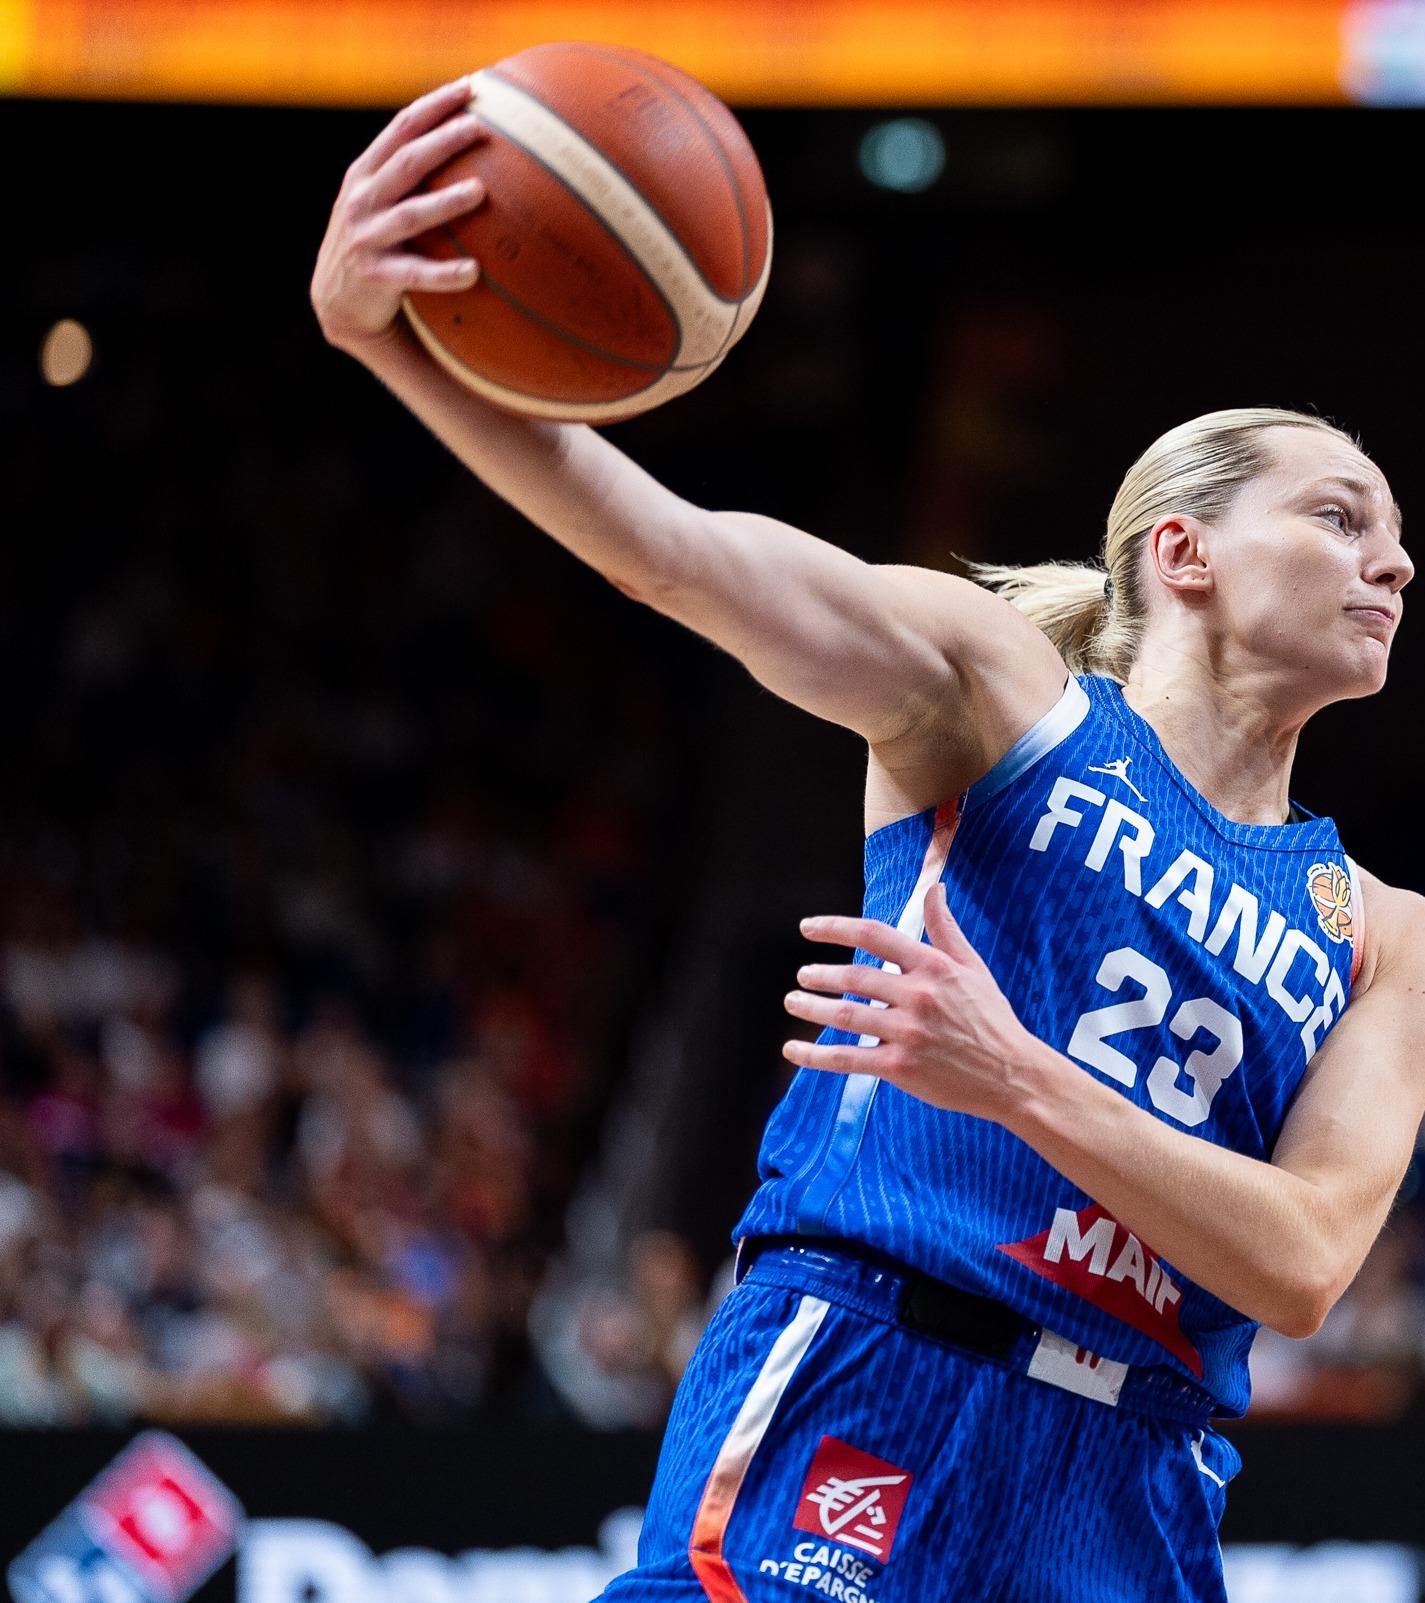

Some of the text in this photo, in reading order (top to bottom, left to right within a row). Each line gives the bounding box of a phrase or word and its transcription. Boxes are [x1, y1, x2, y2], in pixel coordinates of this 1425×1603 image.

[1029, 776, 1346, 1064] FRANCE
[1067, 947, 1244, 1127] 23
[793, 1542, 874, 1588] CAISSE
